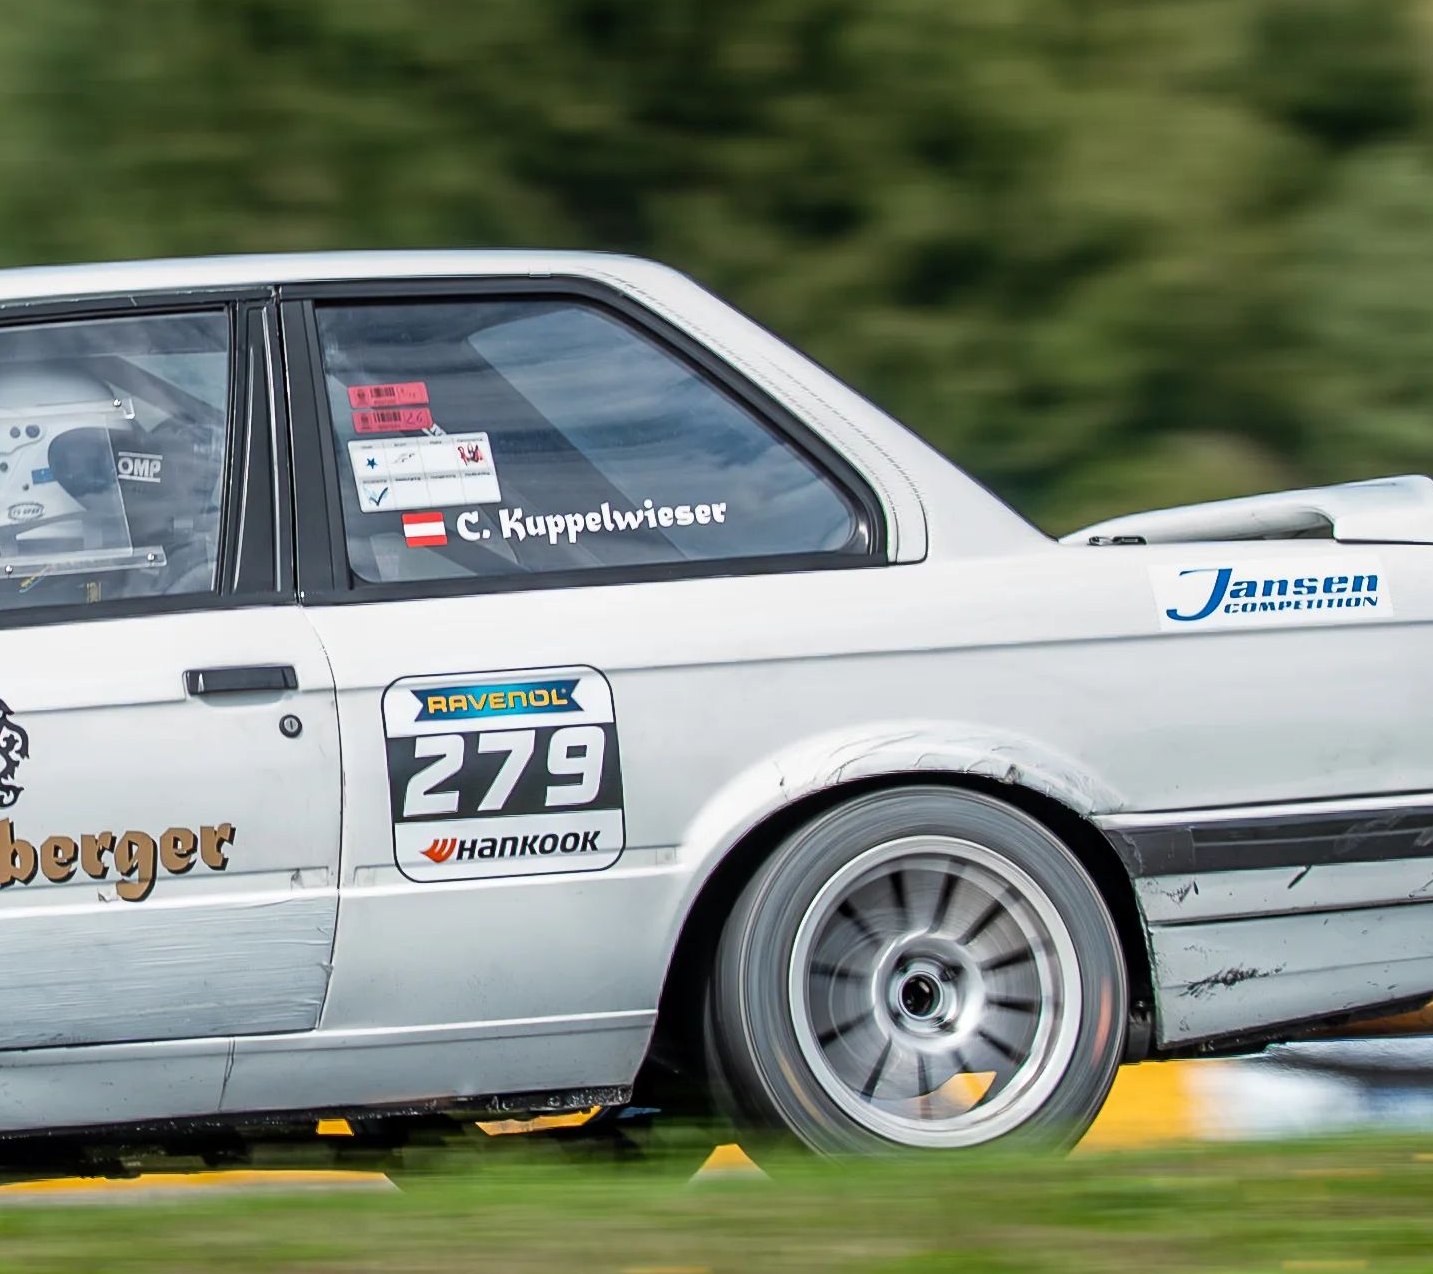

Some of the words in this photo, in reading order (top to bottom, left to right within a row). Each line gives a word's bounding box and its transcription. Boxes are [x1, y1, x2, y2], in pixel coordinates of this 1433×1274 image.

[118, 458, 161, 478] OMP
[456, 511, 490, 541] C.
[498, 499, 727, 545] Kuppelwieser
[1166, 568, 1378, 621] Jansen
[1224, 596, 1378, 614] COMPETITION
[427, 688, 568, 714] RAVENOL
[403, 725, 607, 817] 279
